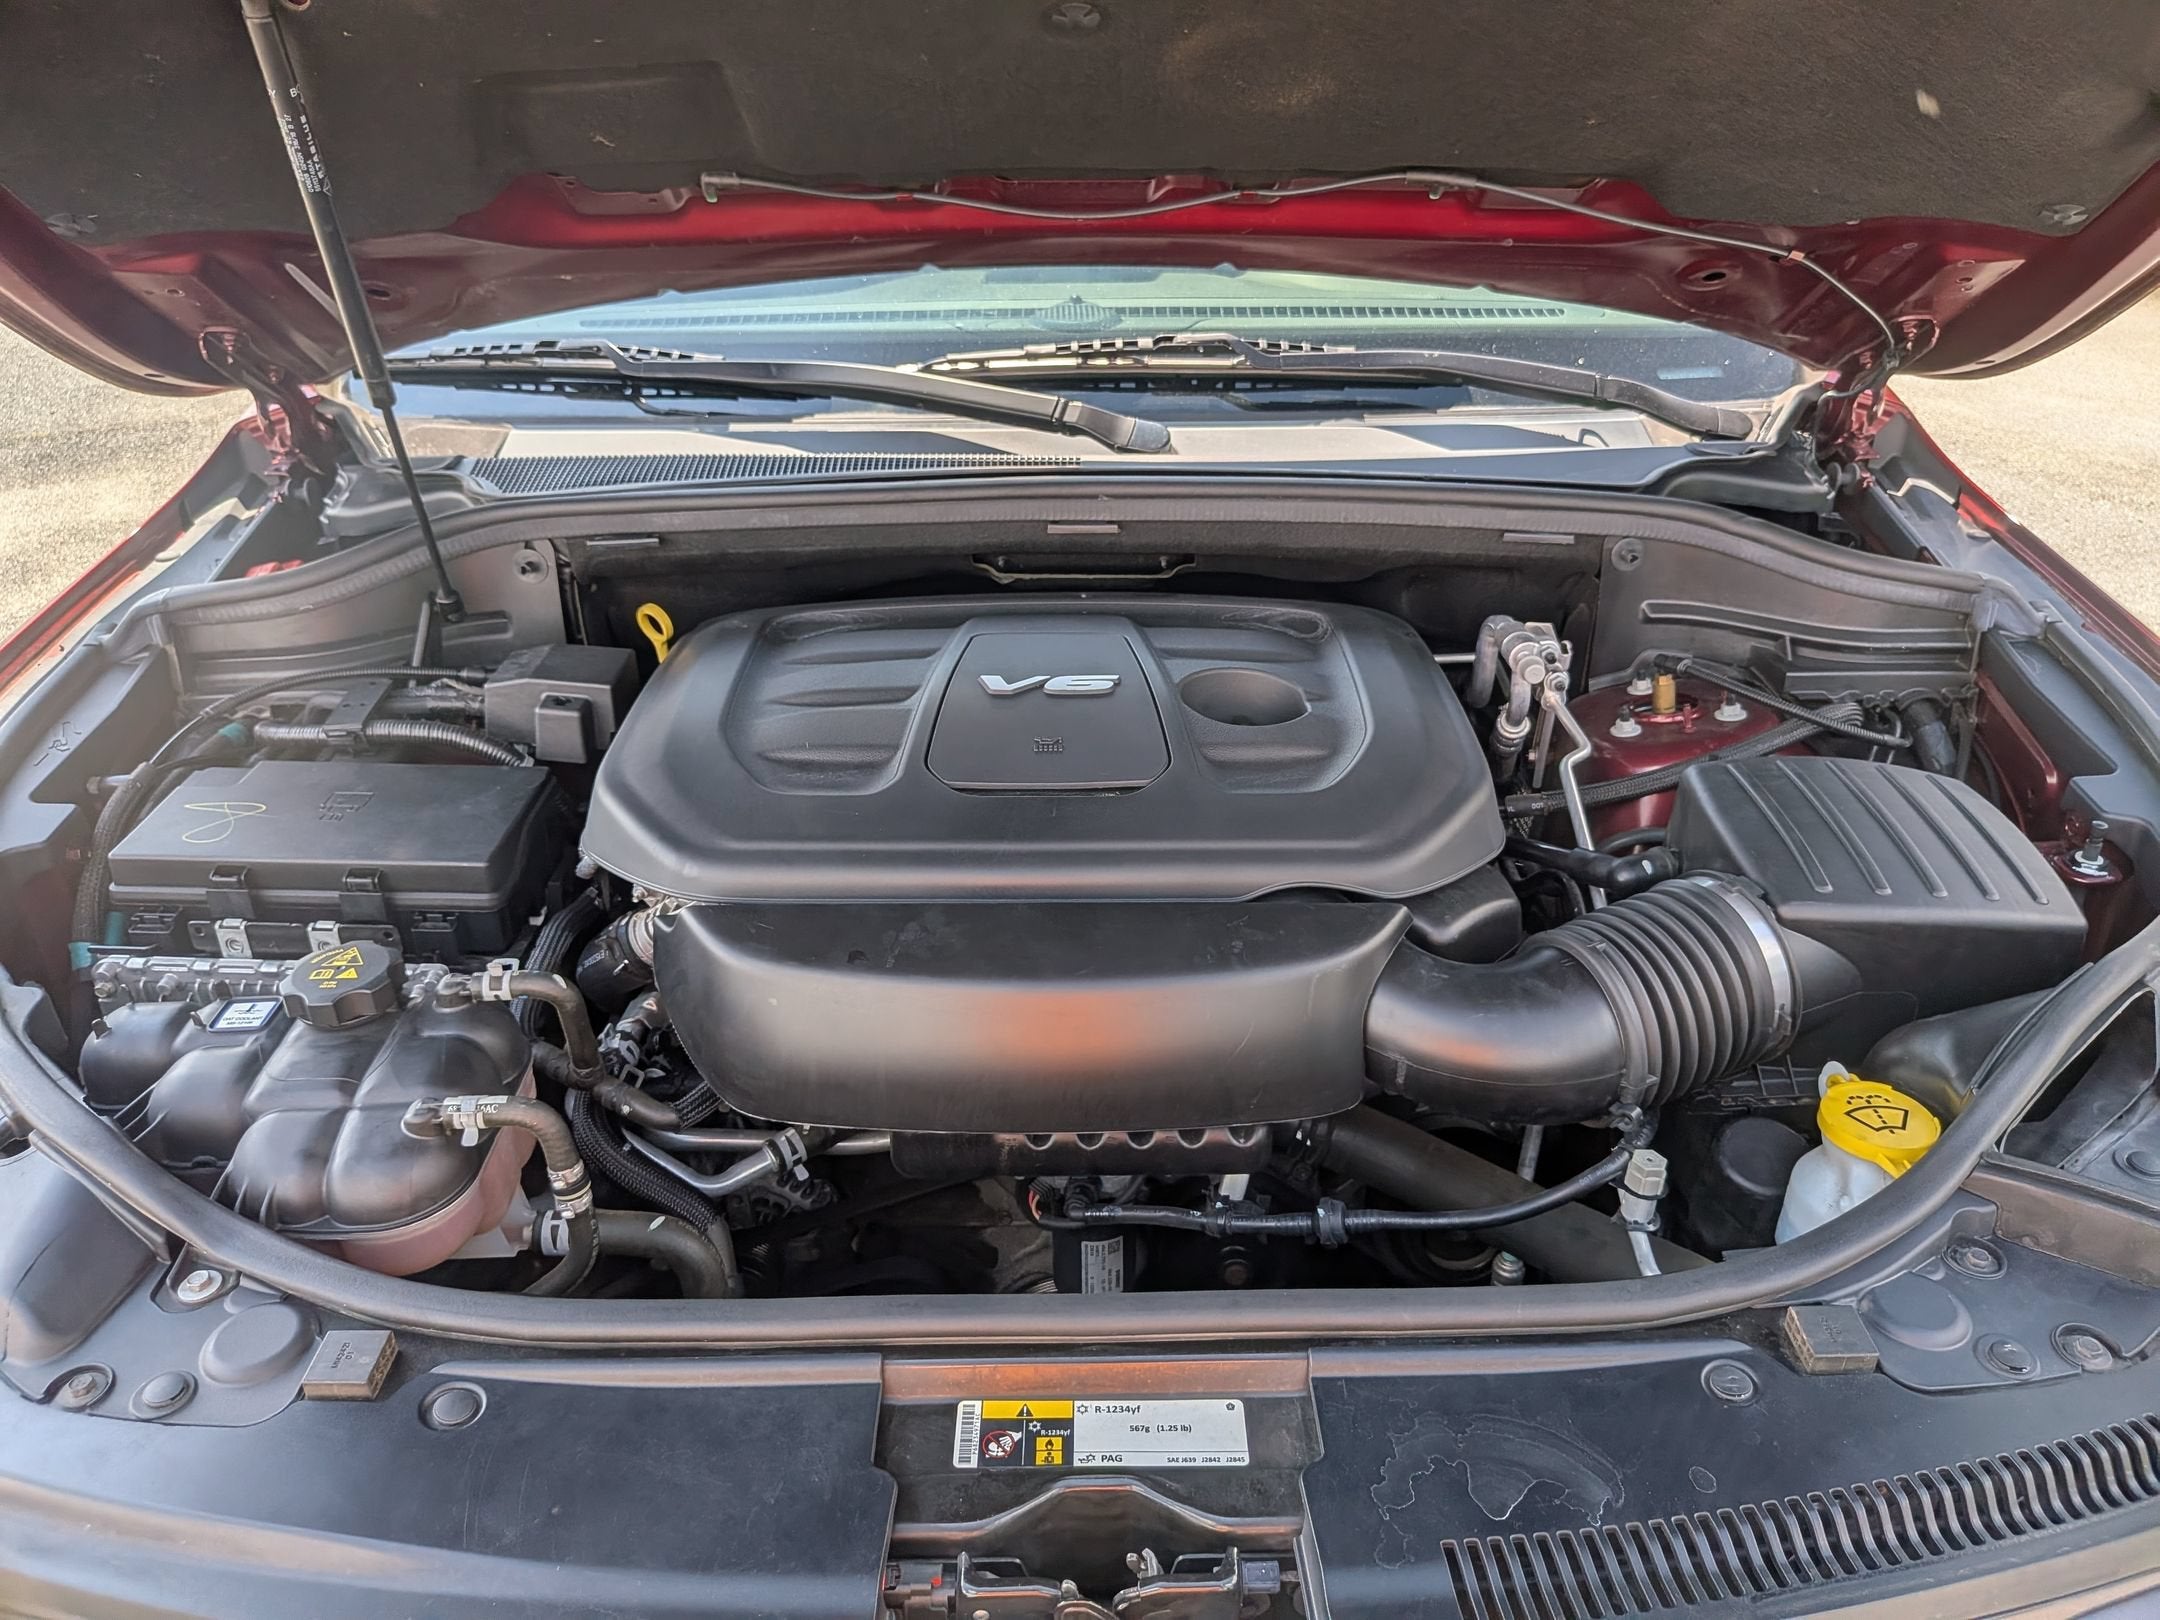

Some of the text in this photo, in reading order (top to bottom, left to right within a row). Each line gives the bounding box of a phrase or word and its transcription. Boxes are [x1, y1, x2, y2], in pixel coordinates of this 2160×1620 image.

[977, 674, 1121, 695] V6
[1094, 1404, 1141, 1415] R-1234yf
[1129, 1424, 1192, 1433] 567g (1.25 lb)
[1101, 1454, 1123, 1462] PAG
